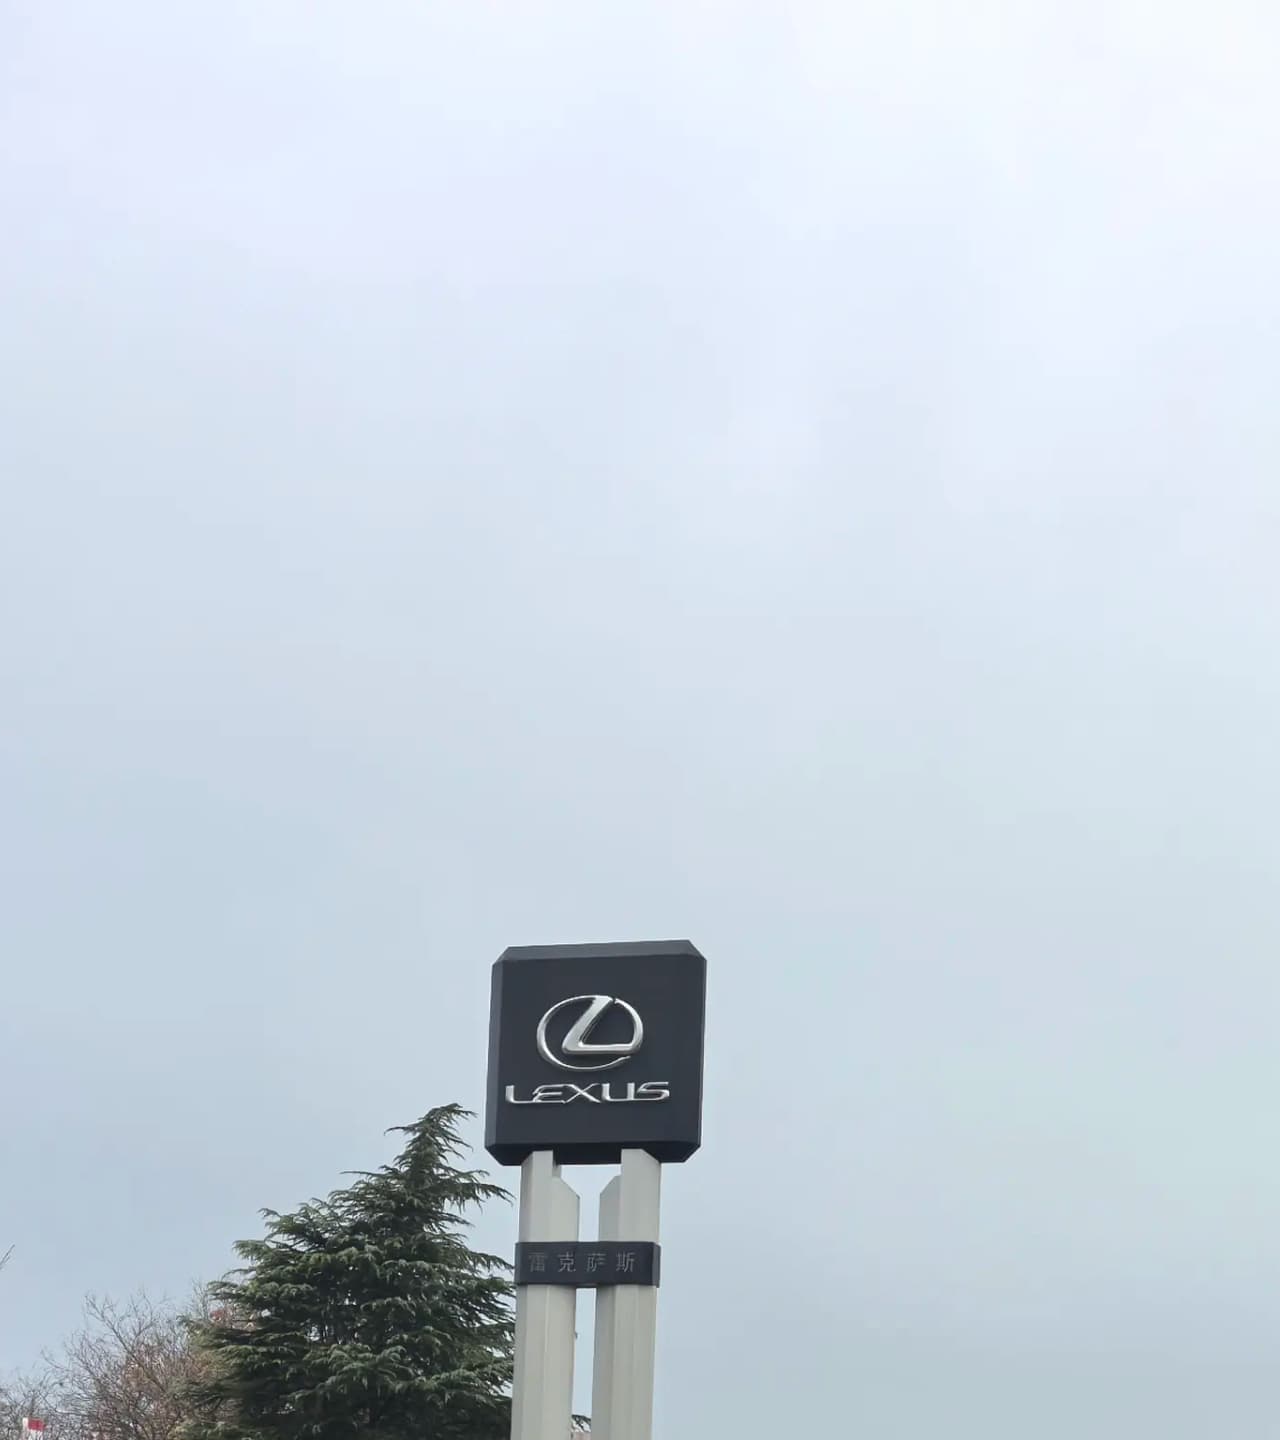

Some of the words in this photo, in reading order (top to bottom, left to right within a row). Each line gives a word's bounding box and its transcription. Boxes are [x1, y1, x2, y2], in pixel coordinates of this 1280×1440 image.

[505, 1081, 670, 1104] LEXUS
[528, 1251, 636, 1273] 雷克萨斯
